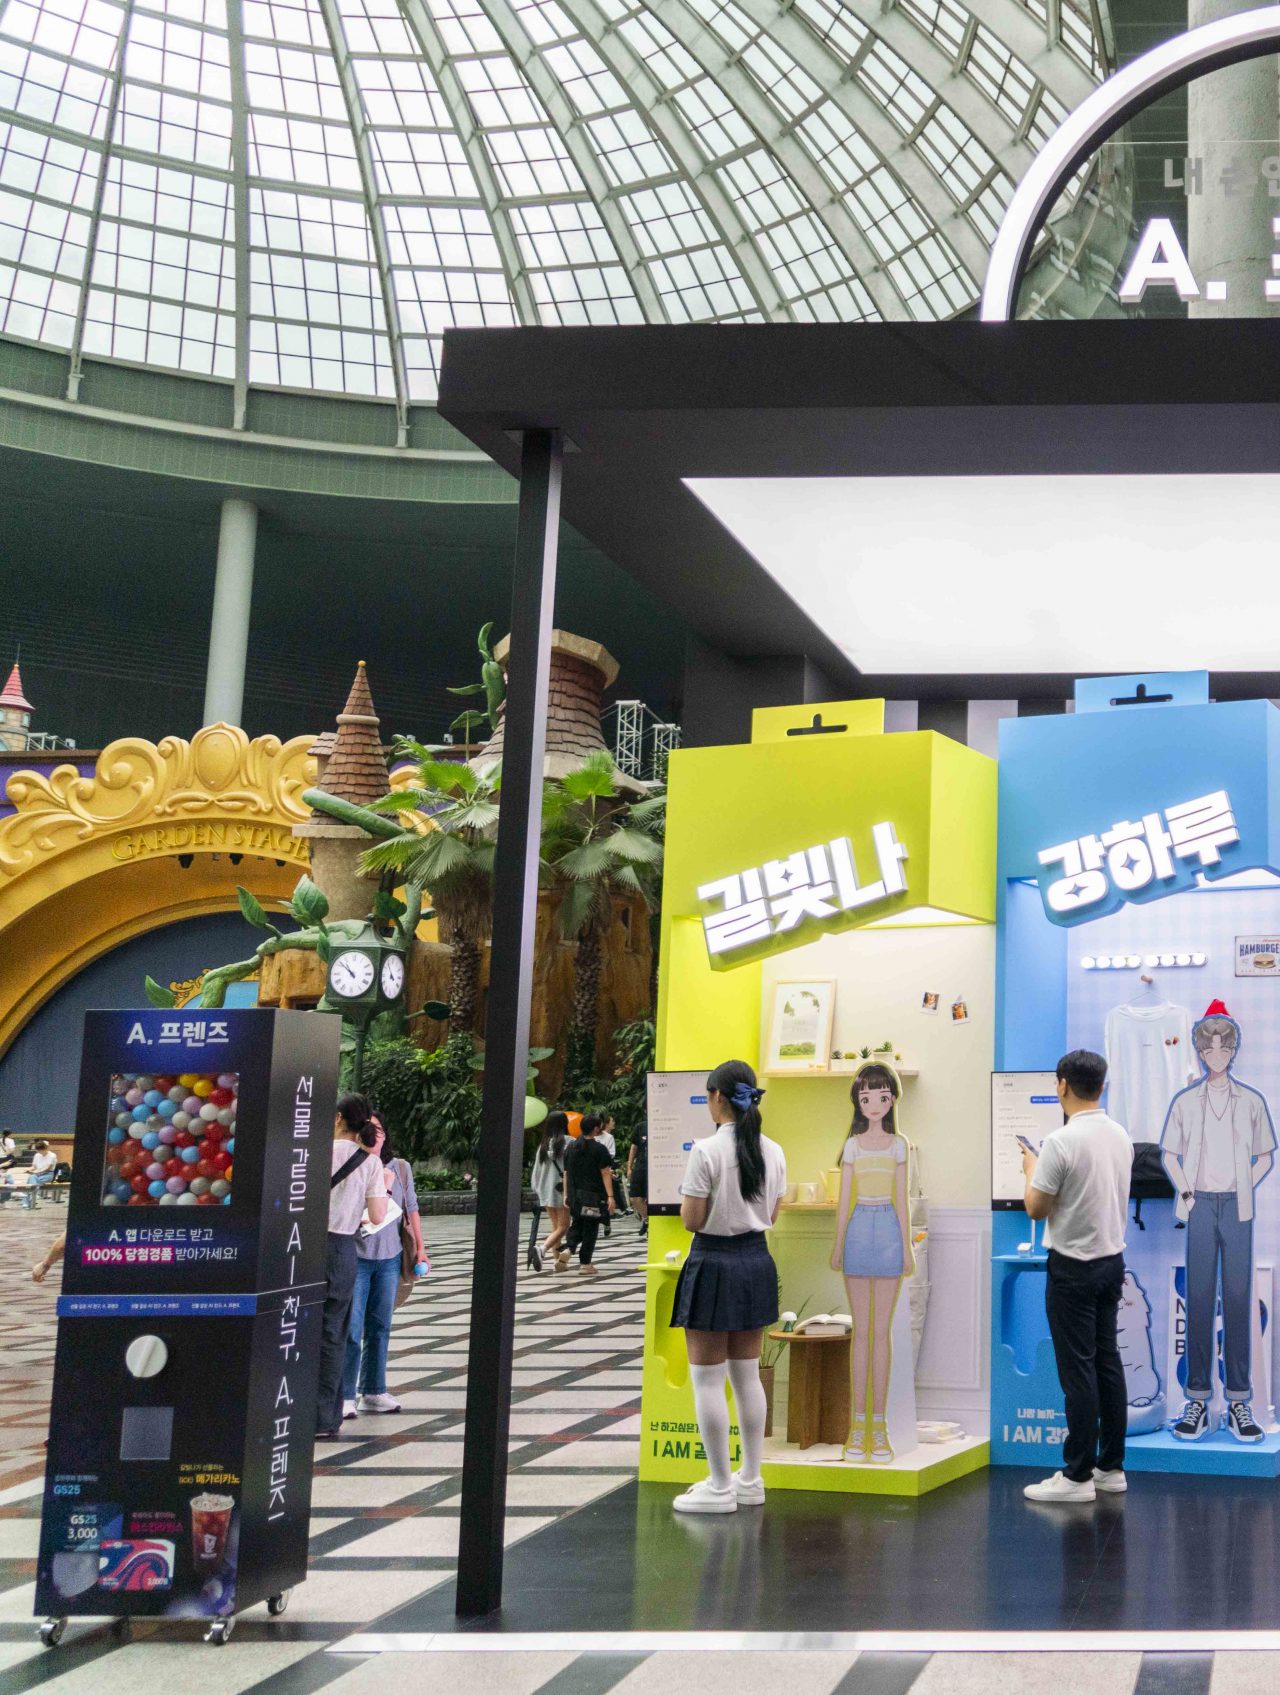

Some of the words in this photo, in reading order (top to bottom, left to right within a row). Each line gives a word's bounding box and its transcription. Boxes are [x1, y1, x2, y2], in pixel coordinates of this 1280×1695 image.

[1164, 157, 1203, 196] 내
[1119, 218, 1227, 303] A.
[111, 823, 226, 861] GARDEN
[229, 824, 310, 860] STAGE
[1038, 790, 1240, 914] 강하루
[697, 821, 909, 956] 길빛나
[126, 1022, 153, 1045] A.
[158, 1021, 229, 1047] 프렌즈
[293, 1076, 313, 1137] 선물
[289, 1149, 309, 1212] 같은
[109, 1229, 122, 1242] A.
[125, 1229, 137, 1242] 앱
[140, 1228, 187, 1242] 다운로드
[190, 1228, 214, 1241] 받고
[85, 1248, 122, 1261] 100%
[125, 1247, 173, 1261] 당첨경품
[175, 1247, 238, 1261] 받아가세요!
[653, 1440, 658, 1457] I
[661, 1440, 691, 1459] AM
[1003, 1424, 1009, 1442] I
[1012, 1425, 1042, 1444] AM
[268, 1416, 290, 1521] 프렌즈
[53, 1484, 81, 1495] GS25
[67, 1528, 98, 1540] 3,000
[70, 1514, 98, 1525] GS25
